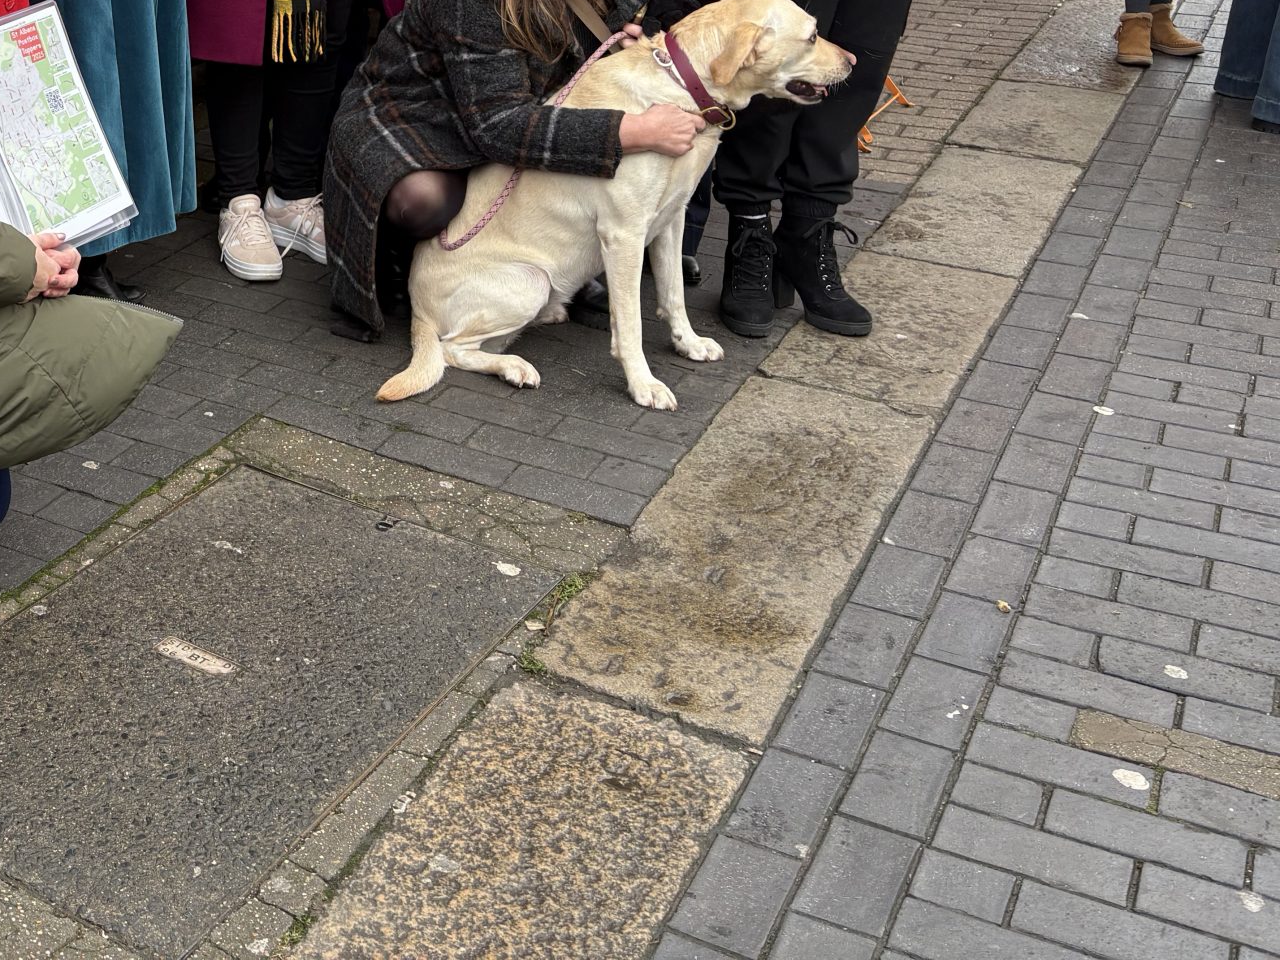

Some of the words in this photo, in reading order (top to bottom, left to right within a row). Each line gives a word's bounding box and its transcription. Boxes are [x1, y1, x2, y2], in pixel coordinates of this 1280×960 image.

[18, 35, 39, 47] Postbox
[21, 43, 42, 55] Toppers
[187, 653, 210, 665] BT
